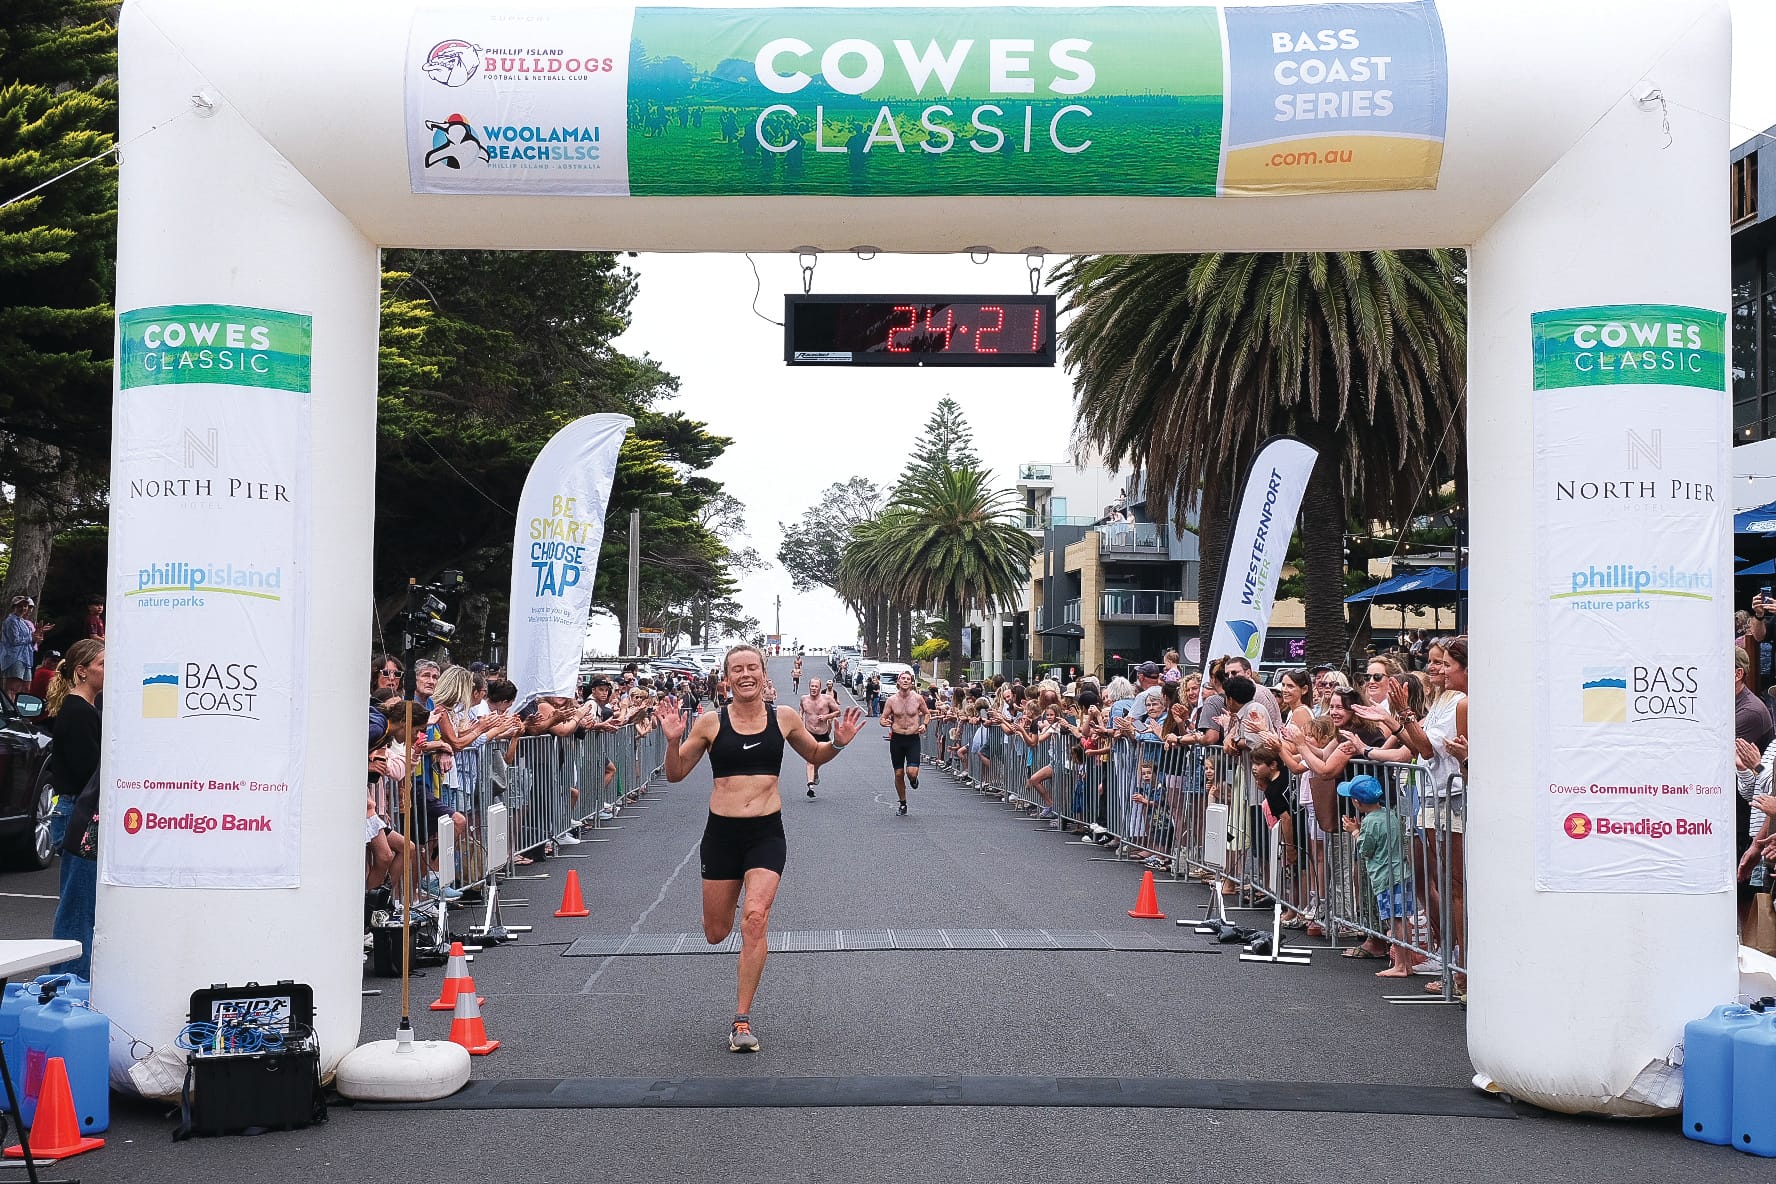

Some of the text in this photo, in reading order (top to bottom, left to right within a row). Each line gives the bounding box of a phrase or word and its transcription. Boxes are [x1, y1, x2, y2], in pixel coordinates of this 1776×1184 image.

[485, 48, 523, 56] PHILLIP
[1271, 28, 1360, 54] BASS
[484, 57, 613, 73] BULLDOGS
[755, 37, 1096, 96] COWES
[1274, 55, 1392, 87] COAST
[1273, 89, 1395, 122] SERIES
[483, 126, 600, 143] WOOLAMAI
[755, 105, 1093, 154] CLASSIC
[1264, 147, 1353, 169] .com.au
[144, 322, 270, 350] COWES
[1573, 322, 1702, 350] COWES
[144, 350, 269, 373] CLASSIC
[1575, 350, 1702, 373] CLASSIC
[130, 477, 291, 503] NORTH PIER
[1557, 479, 1715, 502] NORTH PIER
[551, 495, 577, 519] BE
[529, 517, 594, 544] SMART
[1241, 467, 1283, 605] WESTERNPORT
[531, 541, 586, 565] CHOOSE
[531, 561, 581, 597] TAP
[1253, 558, 1271, 611] WATER
[138, 595, 205, 609] nature parks
[1571, 598, 1650, 612] nature parks
[185, 662, 258, 690] BASS
[1634, 666, 1698, 693] BASS
[185, 692, 258, 712] COAST
[1634, 696, 1698, 715] COAST
[116, 778, 142, 790] Cowes
[143, 779, 205, 792] Community
[249, 781, 289, 792] Branch
[1549, 783, 1587, 794] Cowes
[1589, 783, 1659, 797] Community
[145, 813, 272, 833] Bendigo Bank
[1596, 817, 1713, 839] Bendigo Bank
